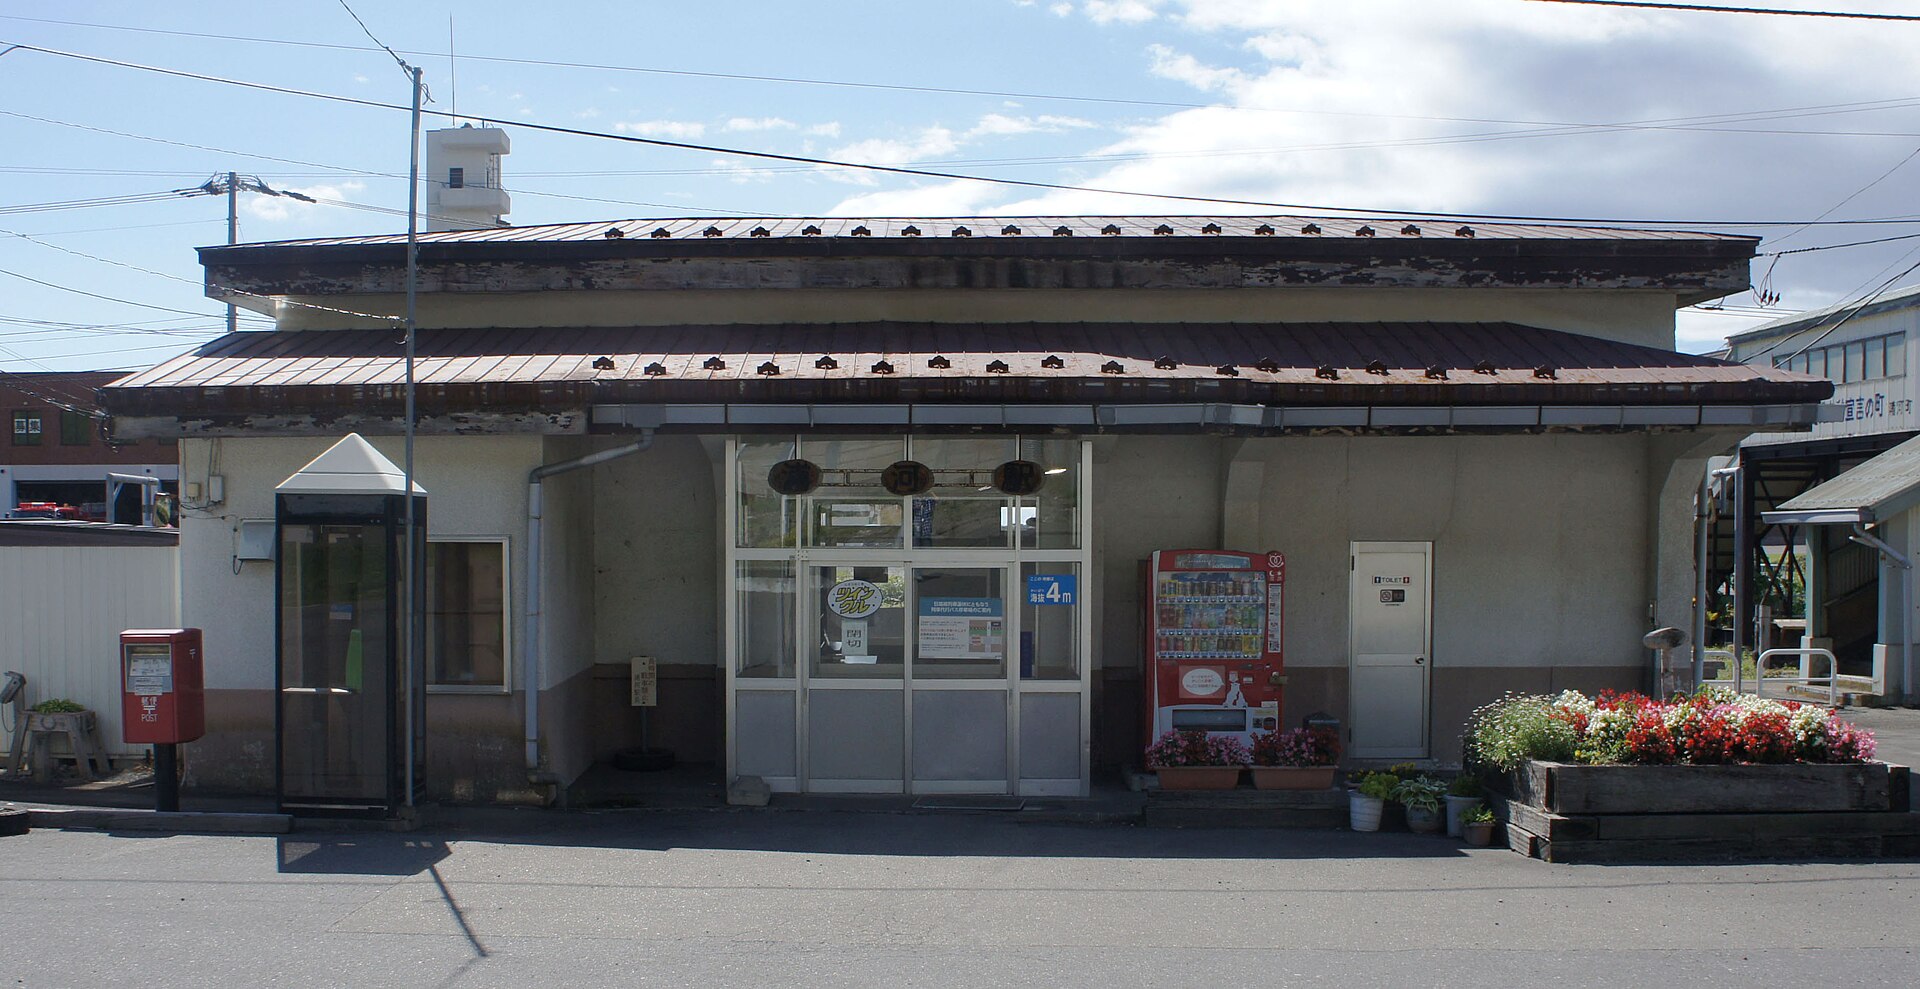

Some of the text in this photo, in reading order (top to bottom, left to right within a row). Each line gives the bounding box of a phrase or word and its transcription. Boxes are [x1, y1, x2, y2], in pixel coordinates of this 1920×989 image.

[15, 419, 41, 433] 募集
[836, 586, 875, 602] ツイン
[841, 600, 870, 614] クル
[141, 696, 157, 705] 郵便
[141, 714, 158, 722] POST
